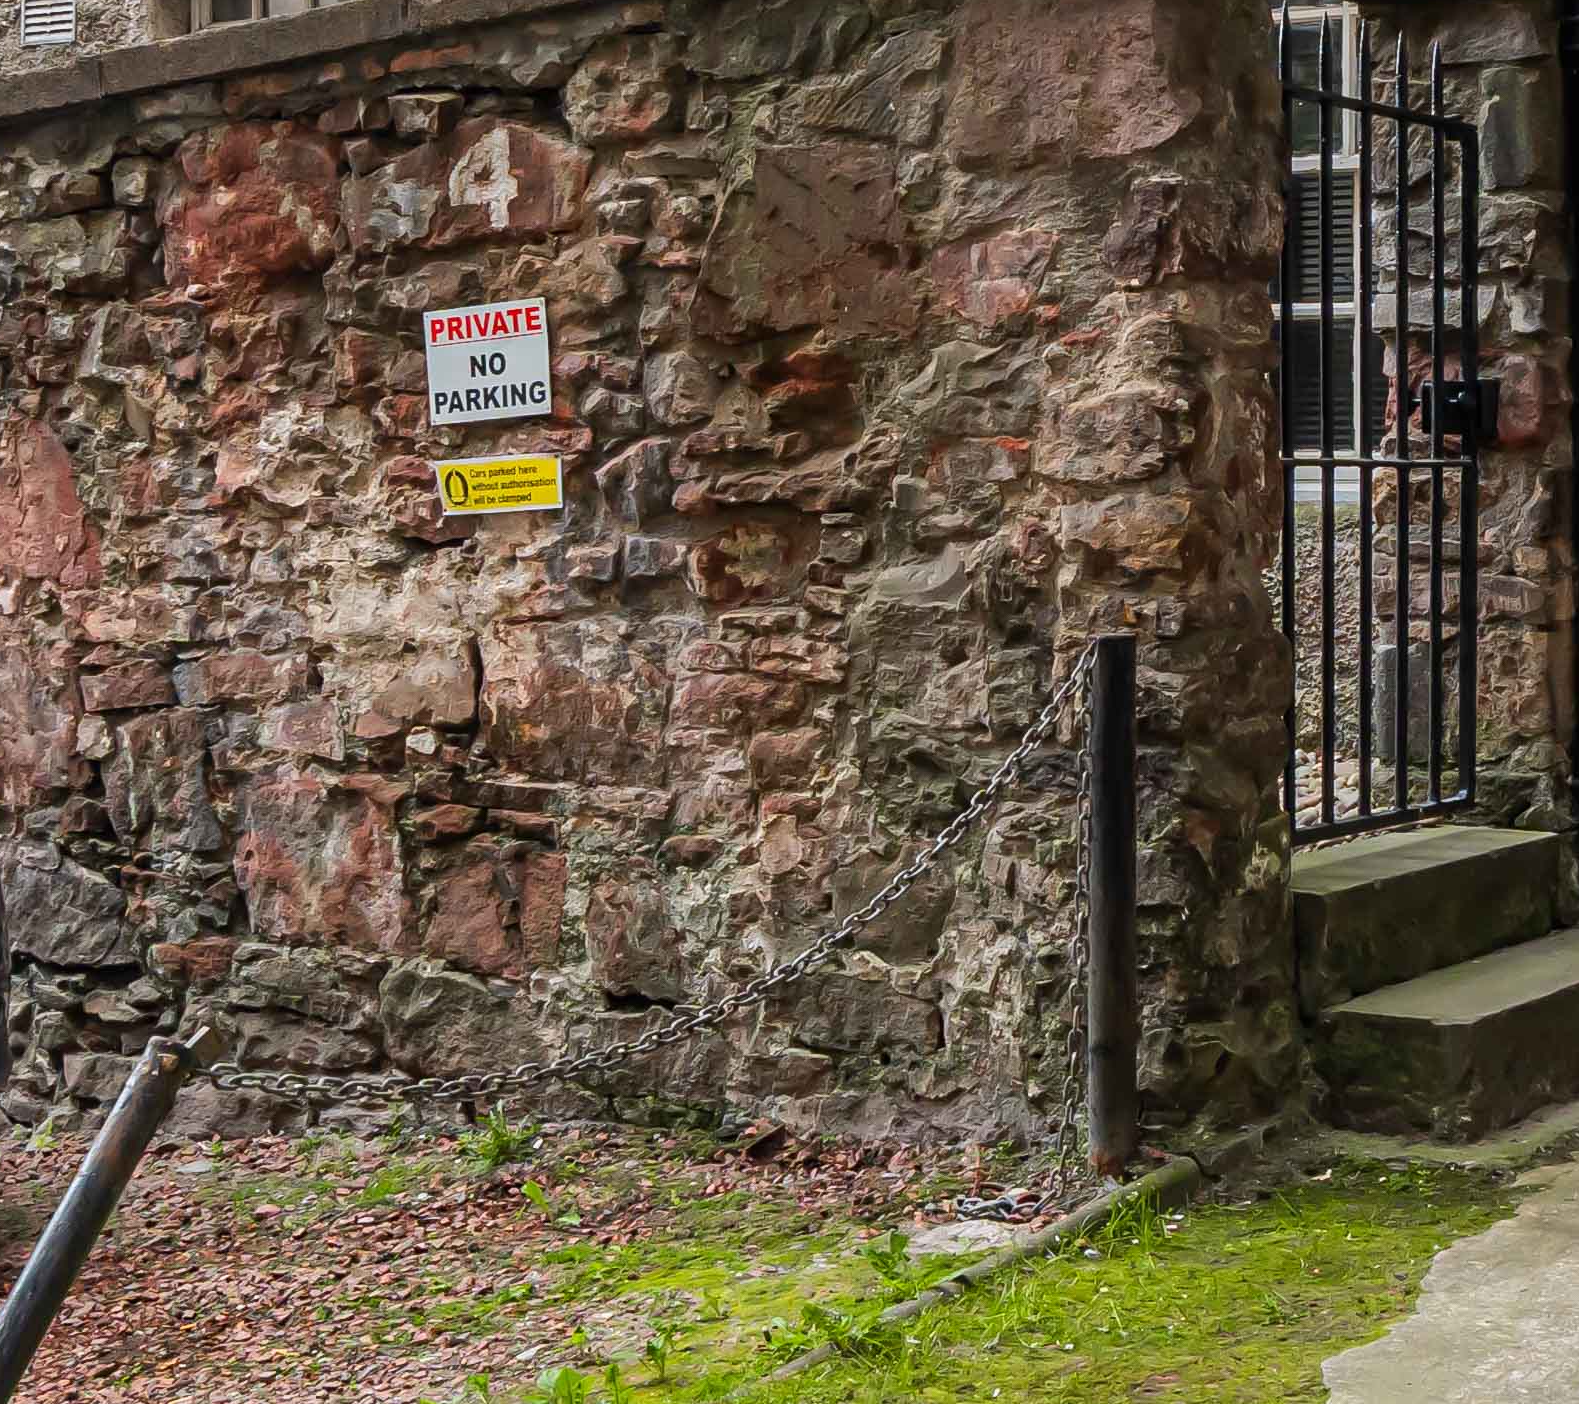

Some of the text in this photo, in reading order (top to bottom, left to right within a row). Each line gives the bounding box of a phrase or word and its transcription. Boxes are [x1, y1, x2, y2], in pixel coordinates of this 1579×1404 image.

[448, 126, 519, 229] 4
[430, 306, 542, 343] PRIVATE
[470, 352, 506, 378] NO
[434, 381, 547, 415] PARKING
[470, 466, 538, 478] Cars parked here
[472, 477, 556, 491] without authorisation
[487, 495, 496, 503] be
